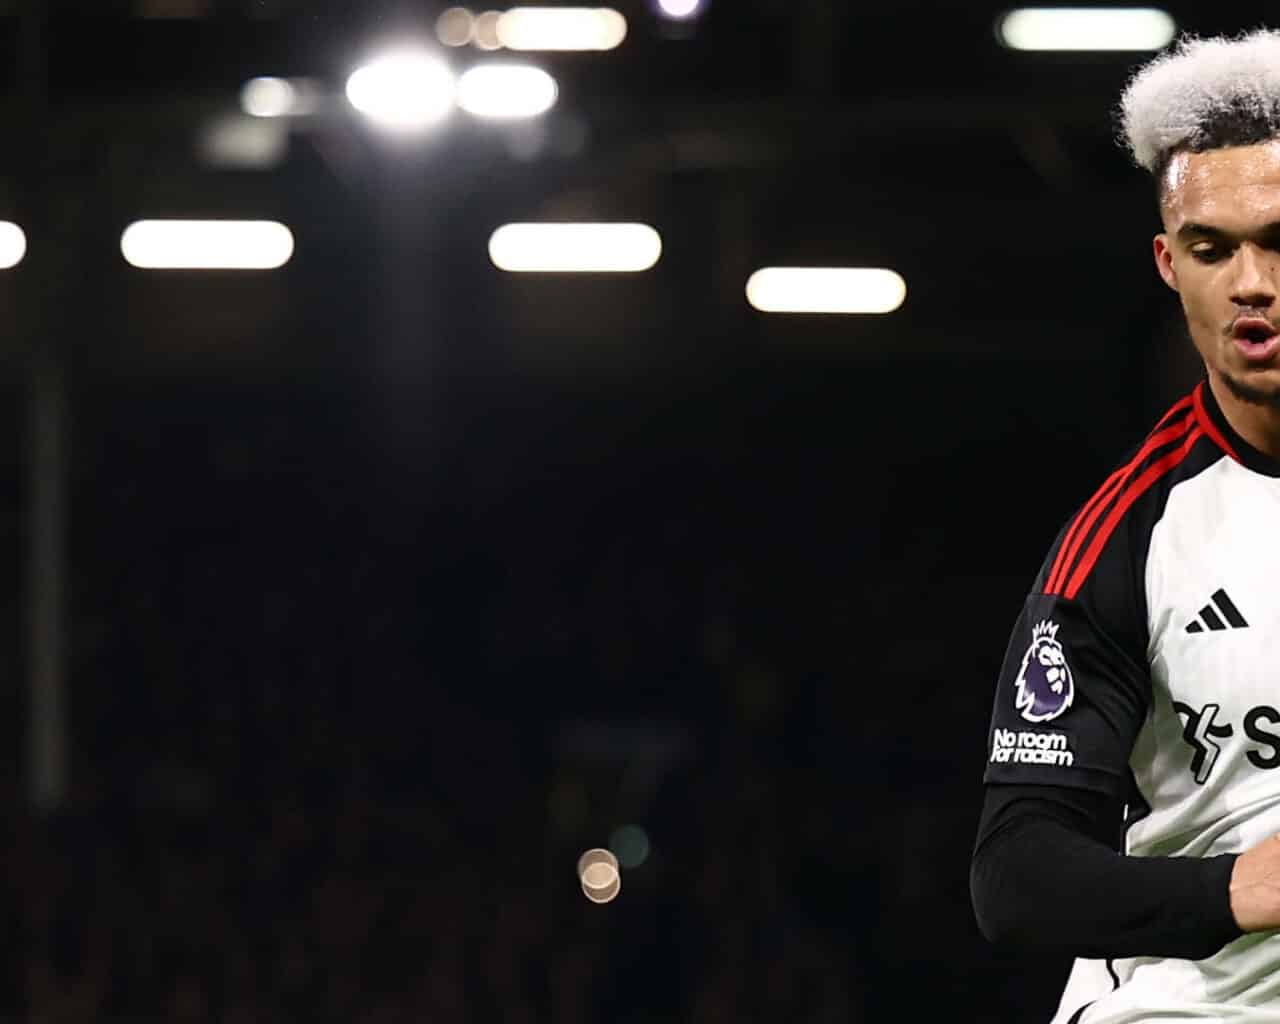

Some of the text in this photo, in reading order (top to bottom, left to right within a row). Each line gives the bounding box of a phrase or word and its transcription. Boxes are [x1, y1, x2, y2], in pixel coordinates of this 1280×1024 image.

[993, 727, 1067, 750] No room
[1014, 748, 1074, 766] racism
